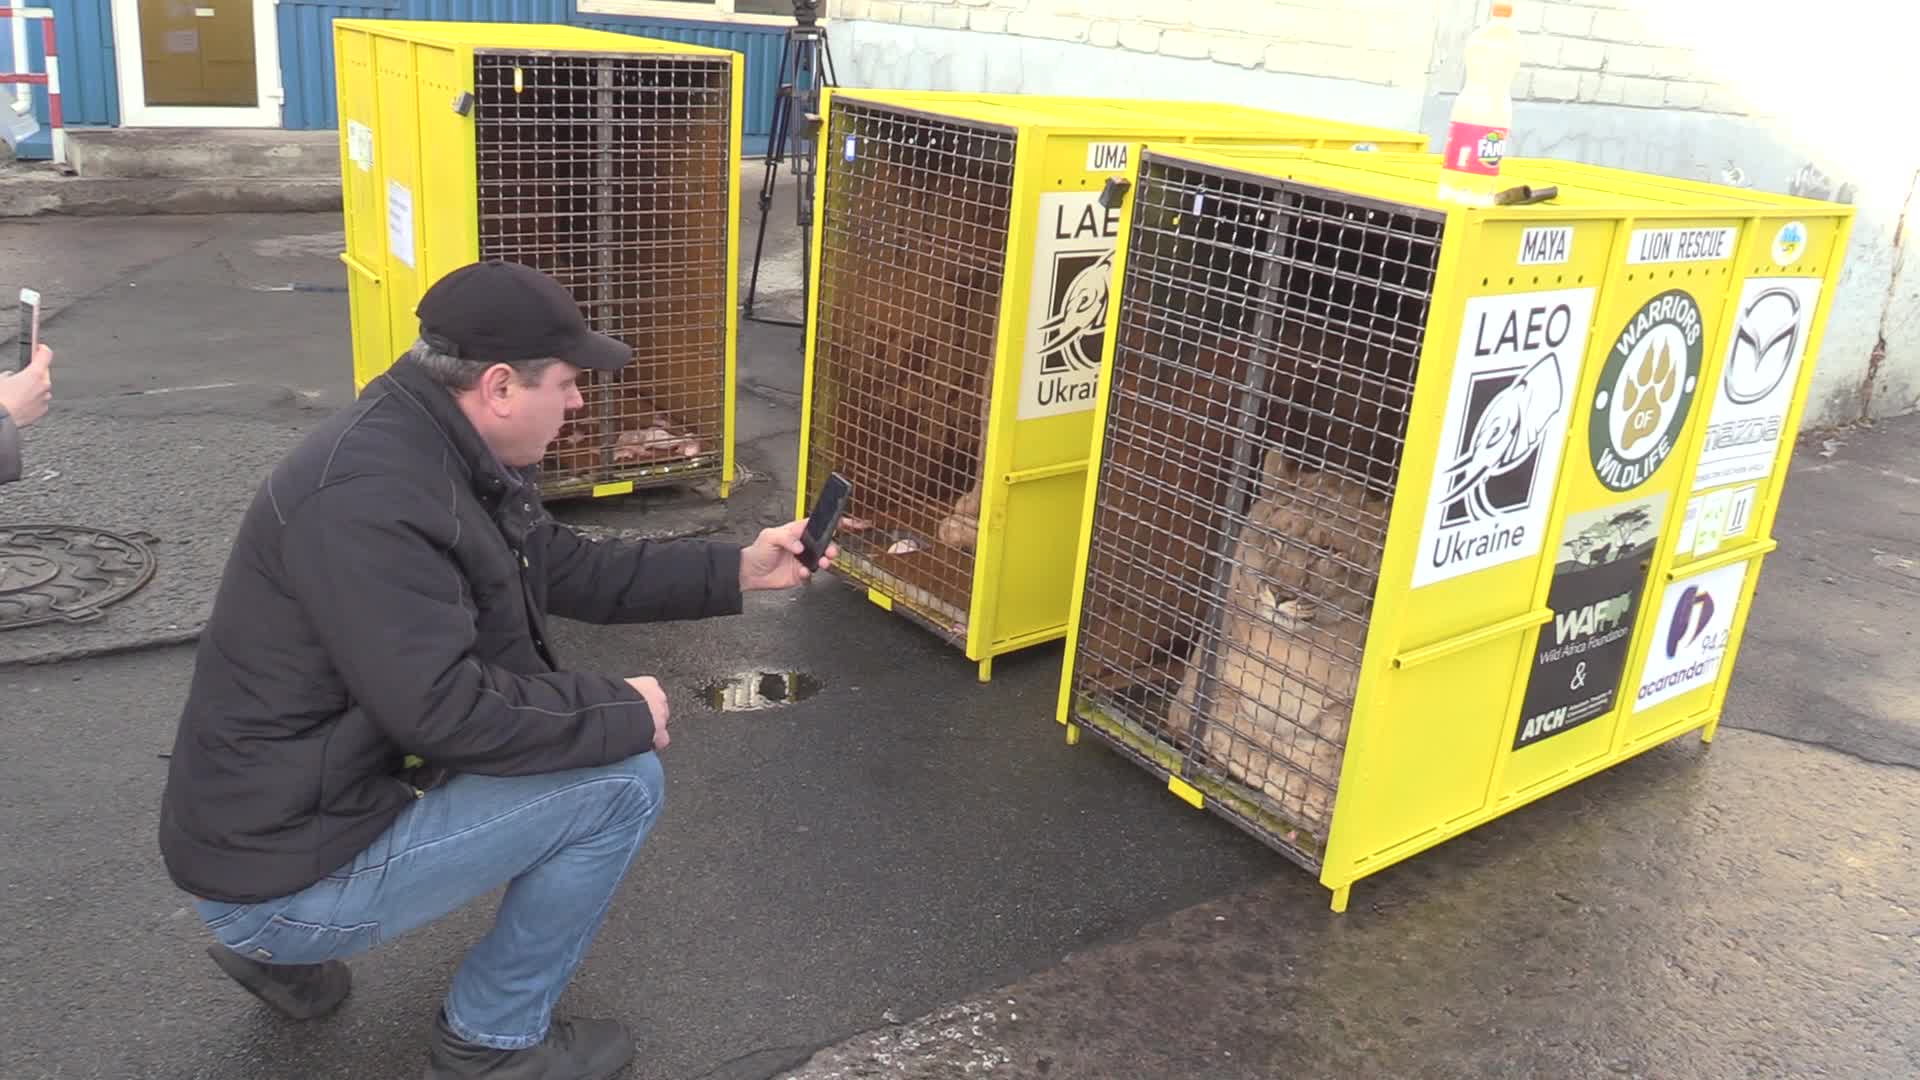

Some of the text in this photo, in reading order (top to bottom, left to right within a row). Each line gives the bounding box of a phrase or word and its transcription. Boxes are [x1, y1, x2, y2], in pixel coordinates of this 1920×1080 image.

[1094, 144, 1127, 169] UMA
[1056, 204, 1120, 240] LAE
[1522, 230, 1565, 262] MAYA
[1640, 230, 1726, 261] LION RESCUE
[1474, 303, 1571, 357] LAEO
[1616, 296, 1700, 356] WARRIORS
[1038, 374, 1098, 406] Ukrai
[1634, 410, 1655, 429] OF
[1596, 435, 1671, 488] WILDLIFE
[1432, 524, 1525, 568] Ukraine
[1556, 599, 1613, 645] WAF
[1540, 626, 1629, 664] Wild Africa Foundation
[1570, 661, 1587, 690] &
[1520, 706, 1568, 741] ATCH
